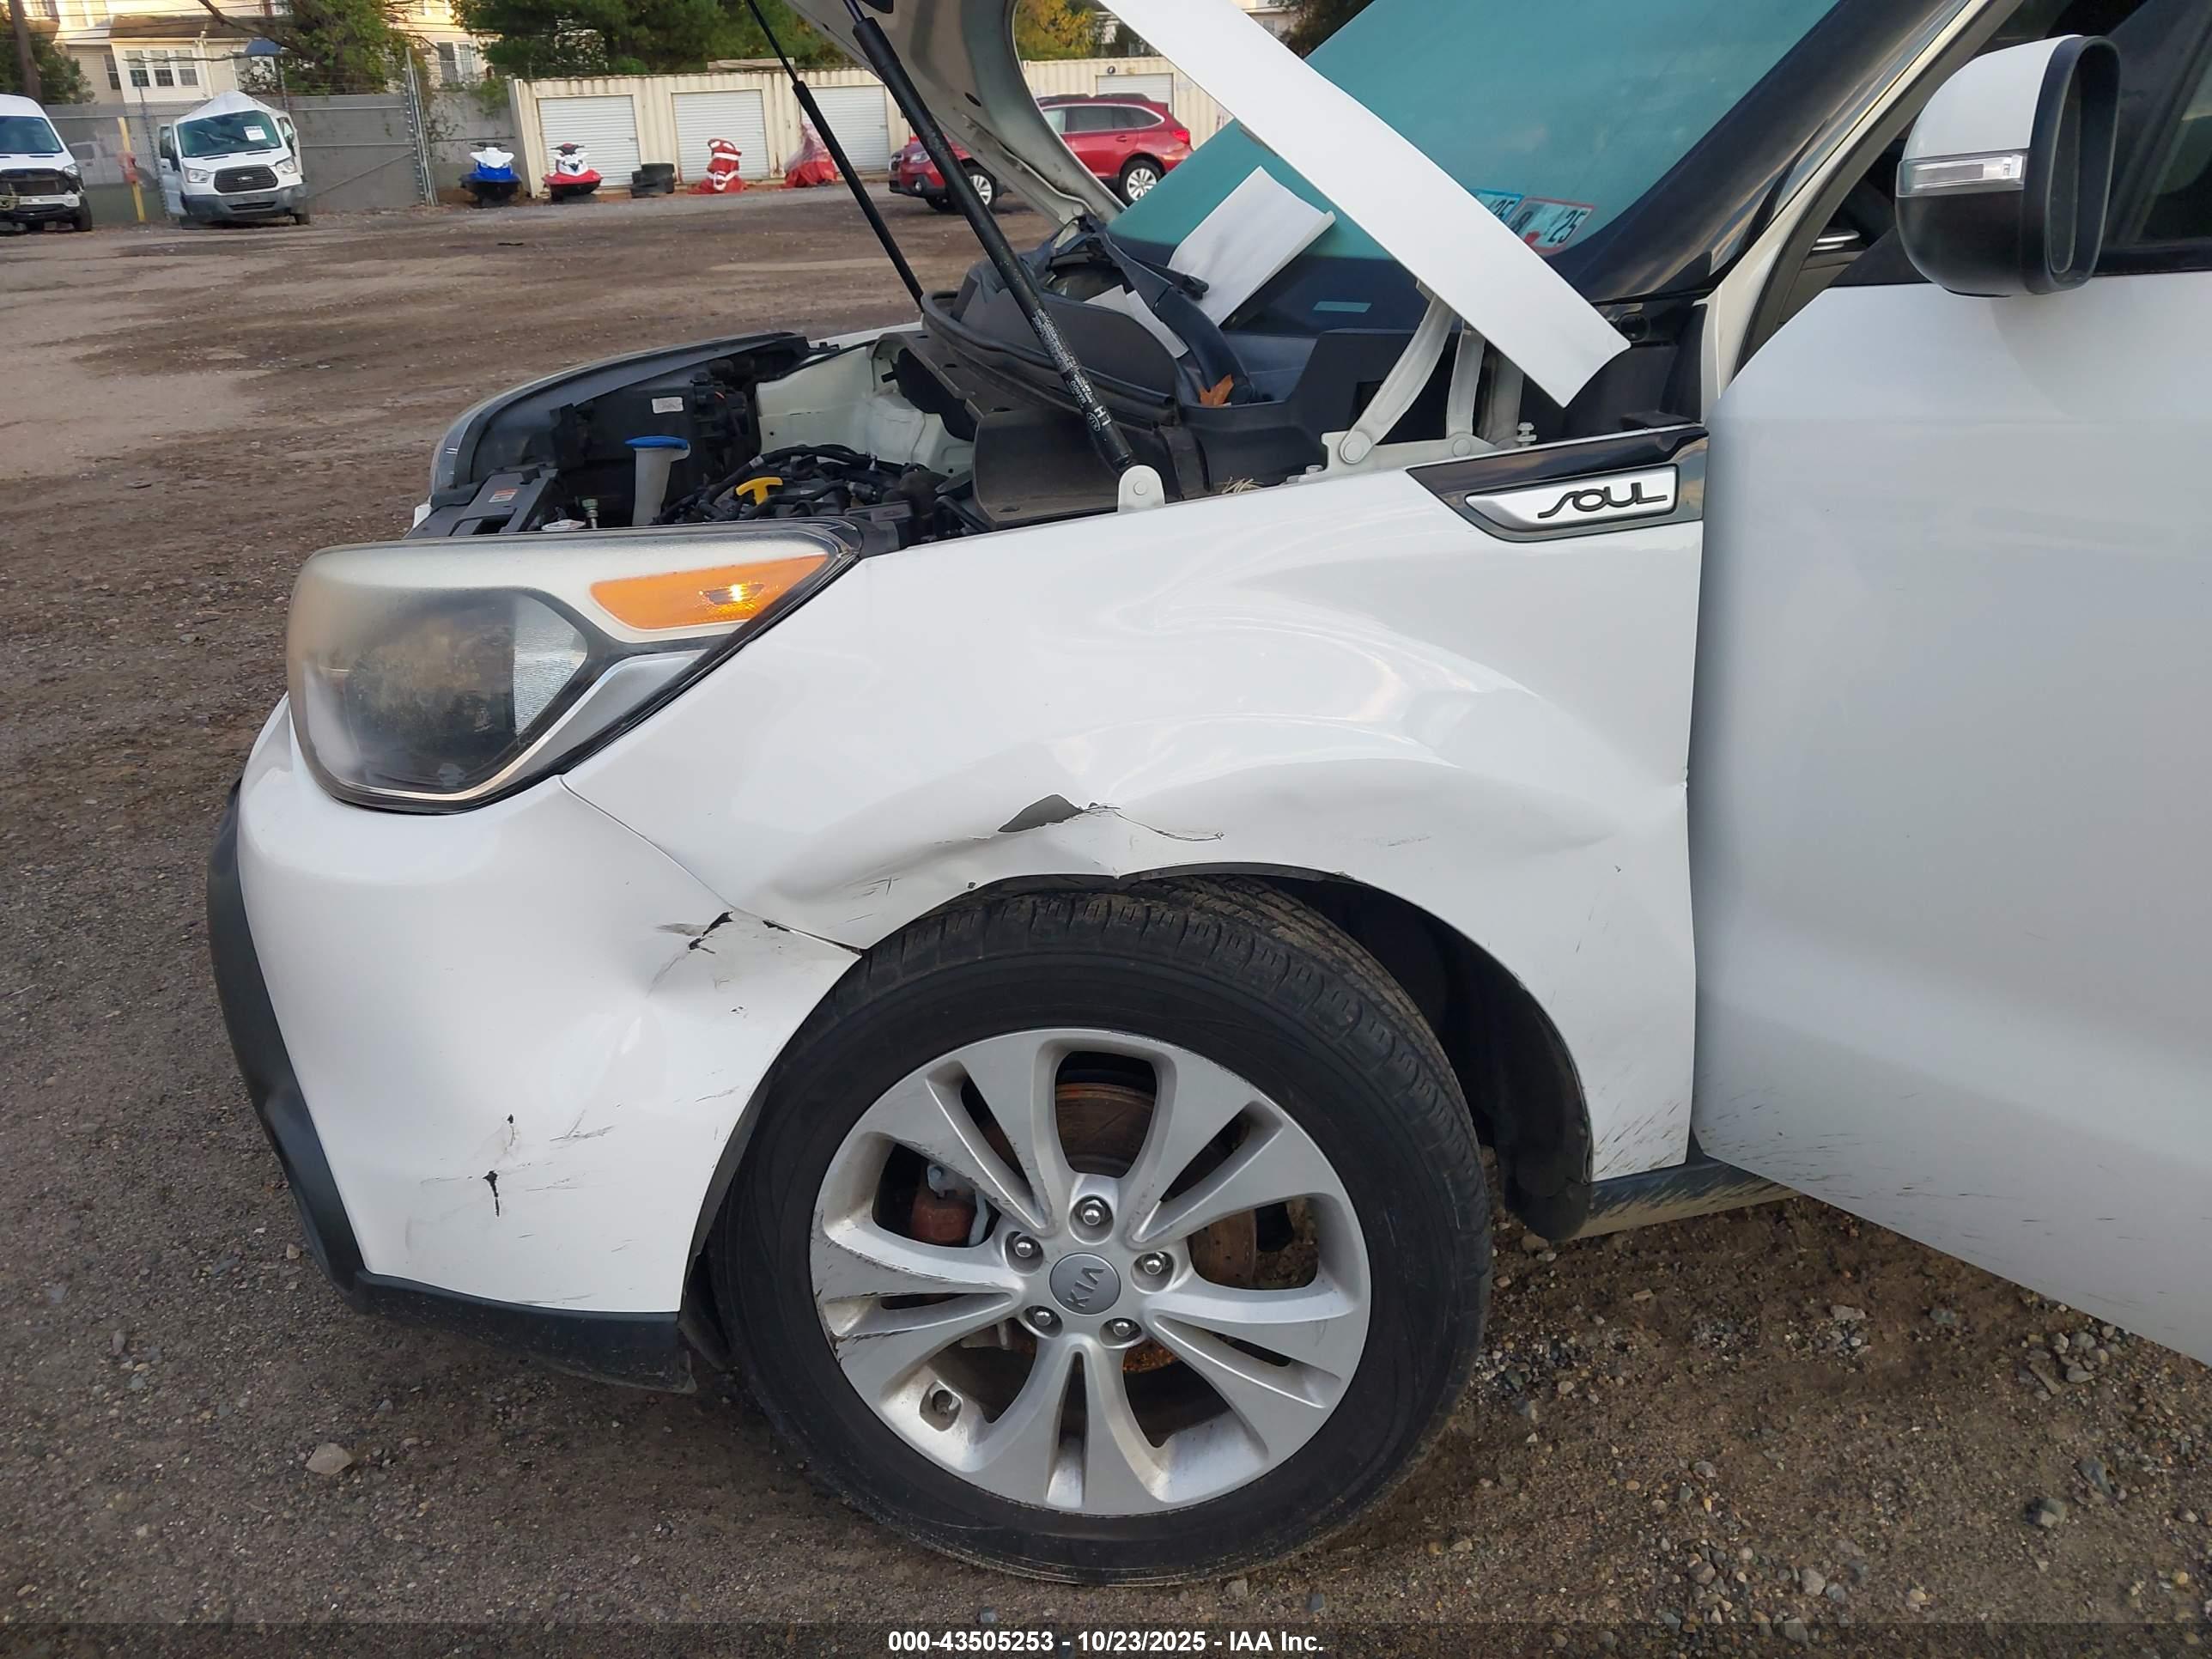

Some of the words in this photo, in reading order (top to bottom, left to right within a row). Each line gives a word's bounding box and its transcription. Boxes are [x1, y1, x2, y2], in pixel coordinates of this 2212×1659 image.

[1547, 210, 1587, 243] 25
[1094, 405, 1112, 426] LH
[1066, 1266, 1106, 1308] KIA
